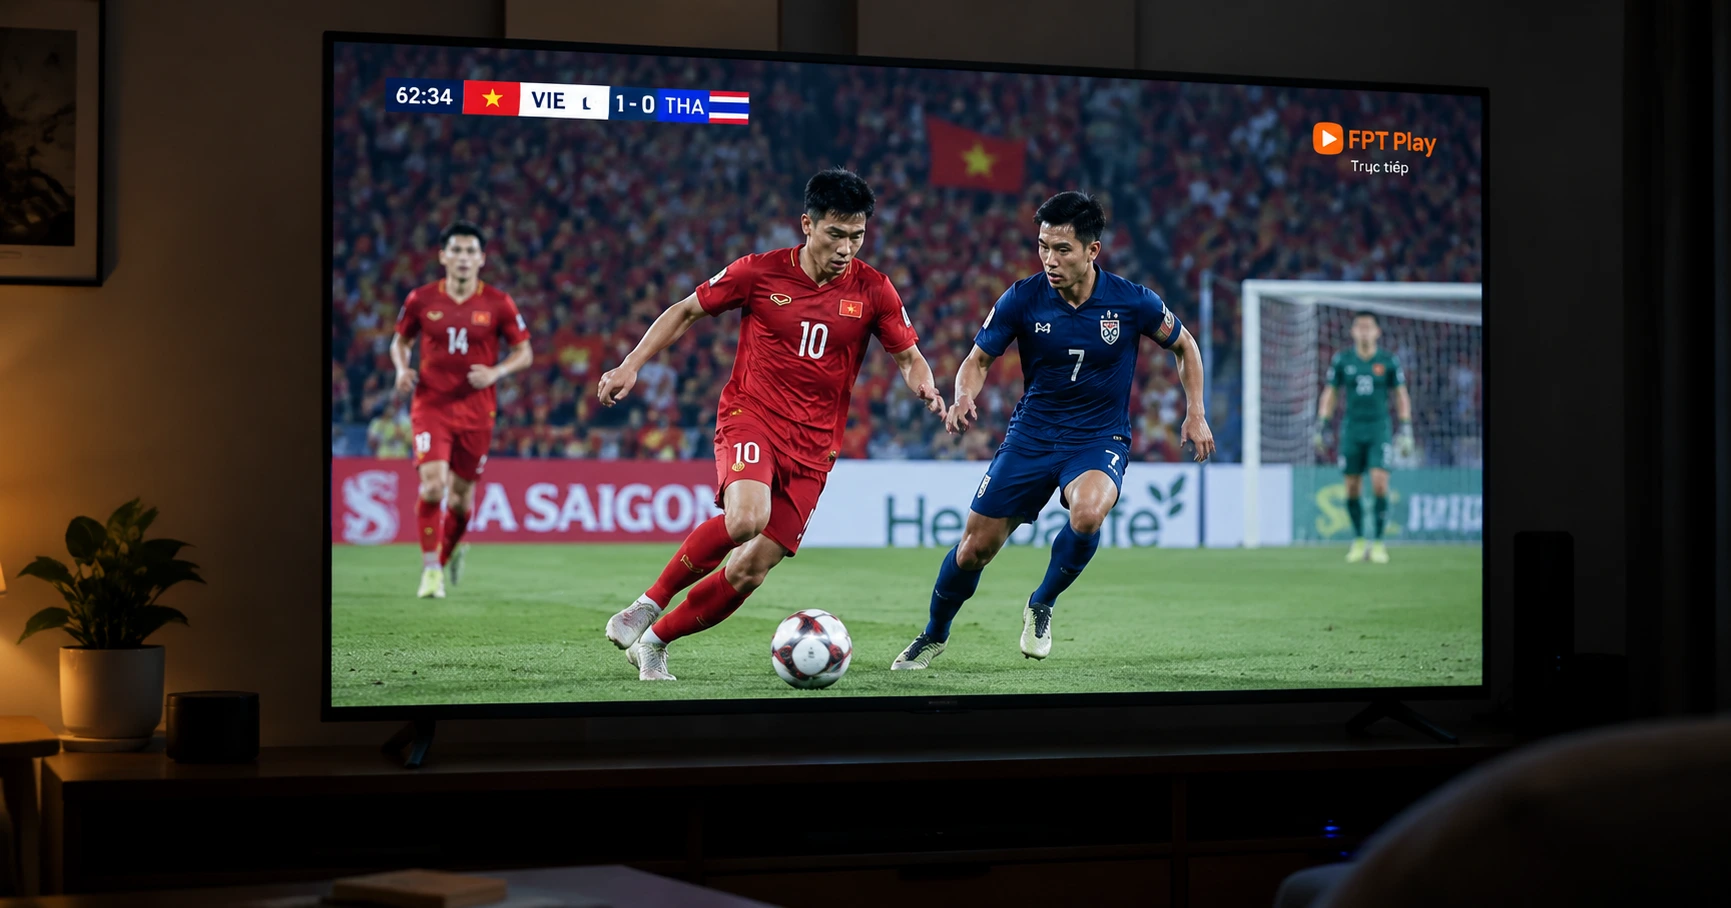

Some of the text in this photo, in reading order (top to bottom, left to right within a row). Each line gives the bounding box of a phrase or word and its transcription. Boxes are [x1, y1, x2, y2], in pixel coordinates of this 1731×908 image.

[396, 86, 453, 106] 62:34
[531, 91, 566, 110] VIE
[665, 96, 705, 115] THA
[1348, 129, 1437, 158] FPT Play
[446, 326, 469, 355] 14
[798, 320, 829, 360] 10
[1068, 348, 1085, 382] 7
[733, 441, 760, 464] 10
[1105, 449, 1120, 467] 7
